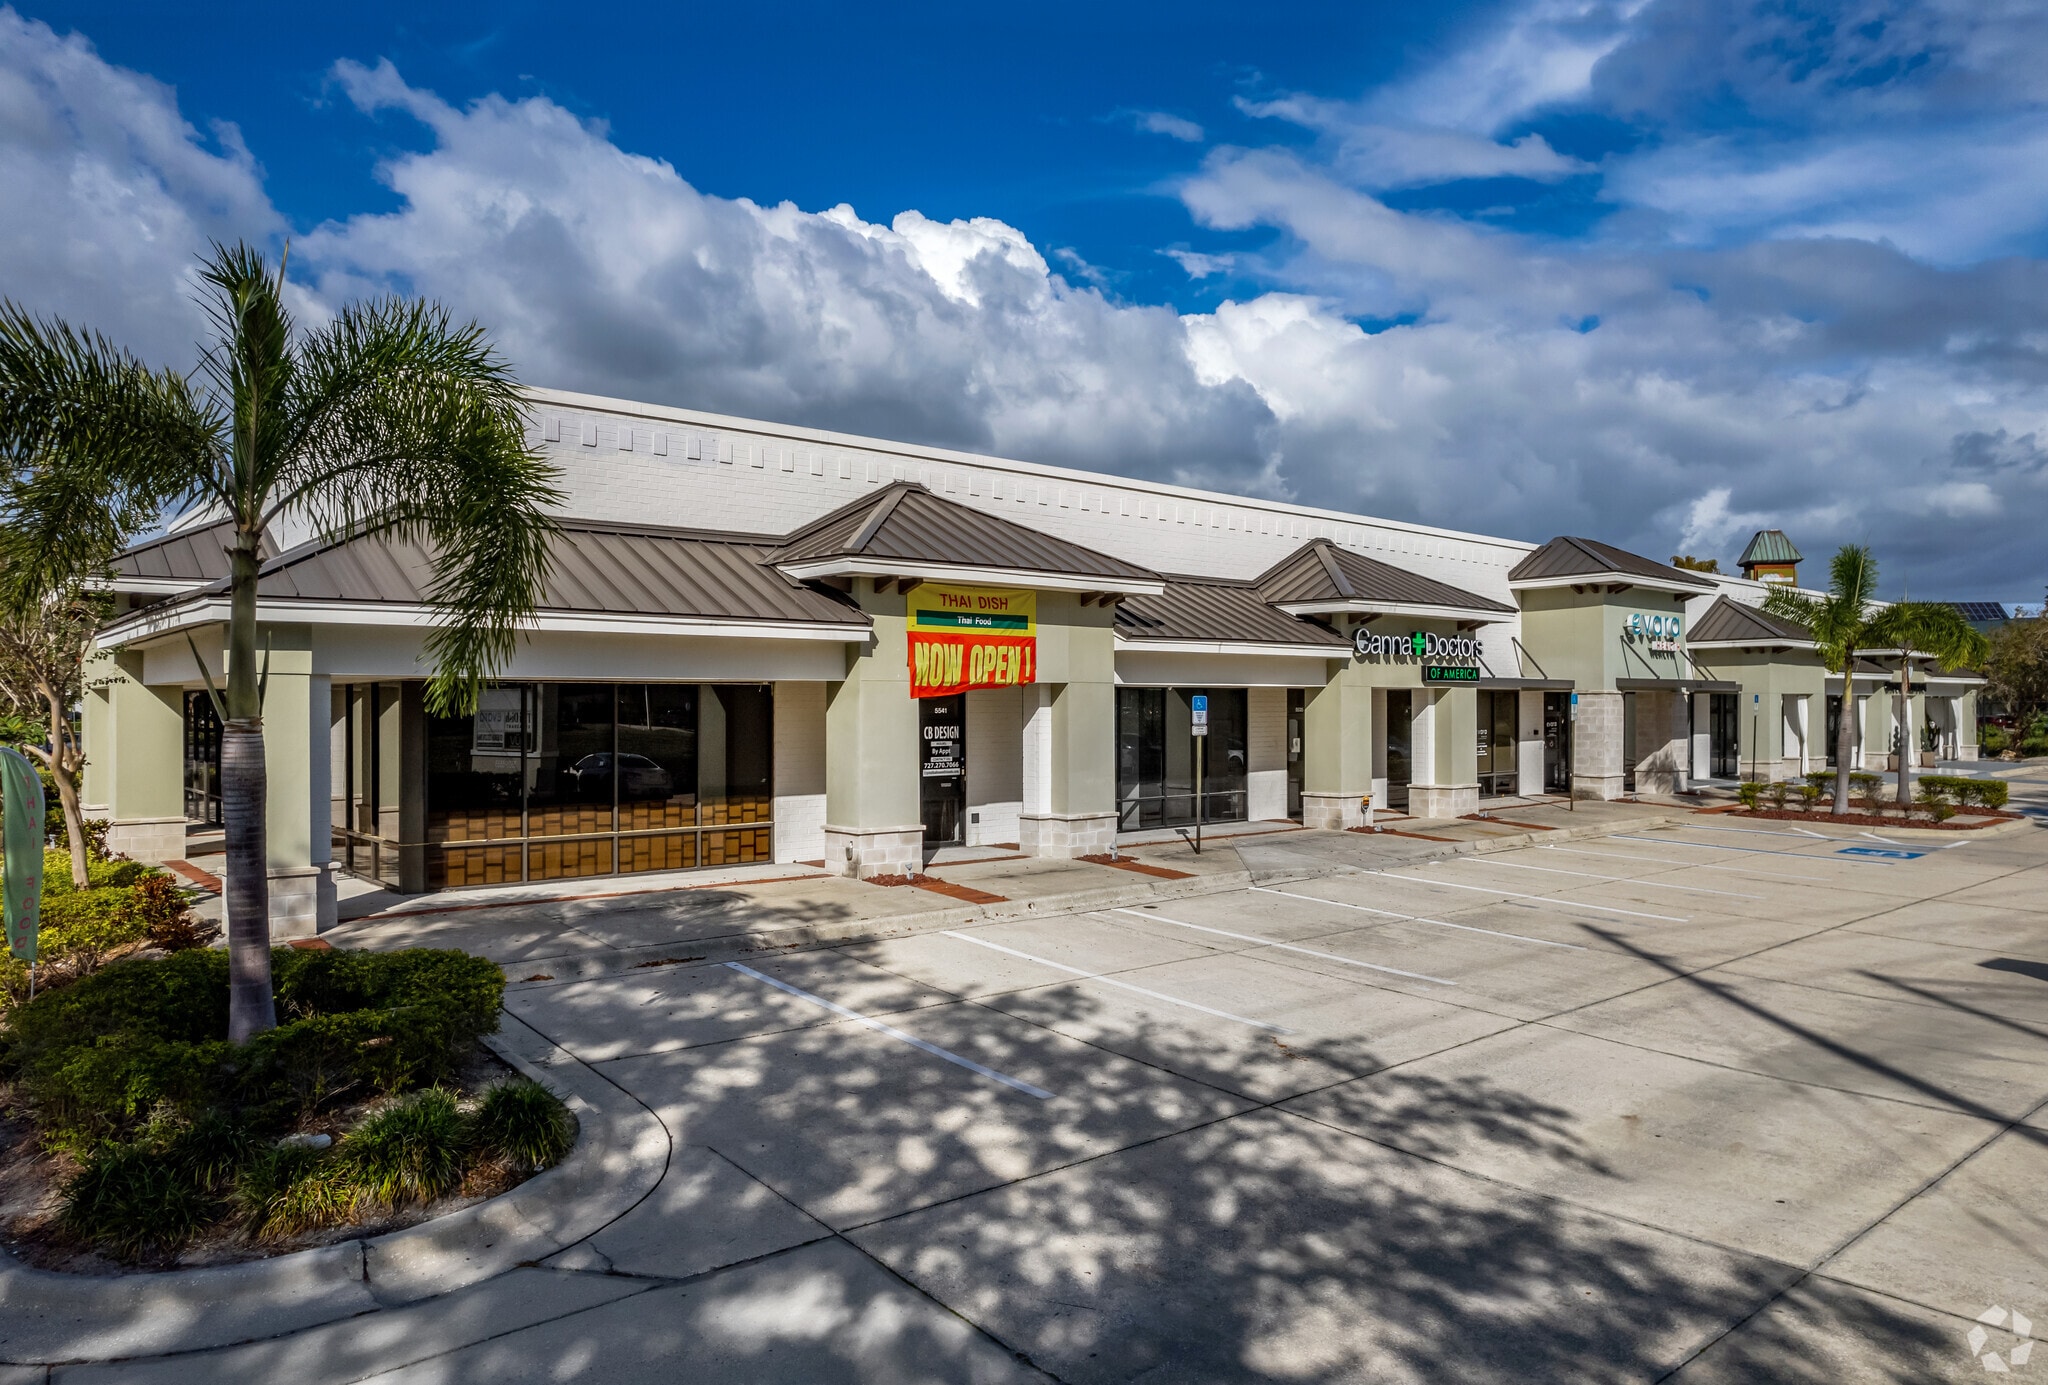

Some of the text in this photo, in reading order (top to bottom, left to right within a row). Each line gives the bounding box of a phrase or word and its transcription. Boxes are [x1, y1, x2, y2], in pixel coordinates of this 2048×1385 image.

[940, 593, 1008, 610] THAI DISH
[957, 616, 991, 625] Thai Food
[1629, 613, 1680, 637] evara
[1356, 628, 1482, 657] Canna Doctors
[914, 642, 963, 687] NOW
[1430, 667, 1477, 679] OF AMERICA
[924, 726, 959, 739] CB DESIGN
